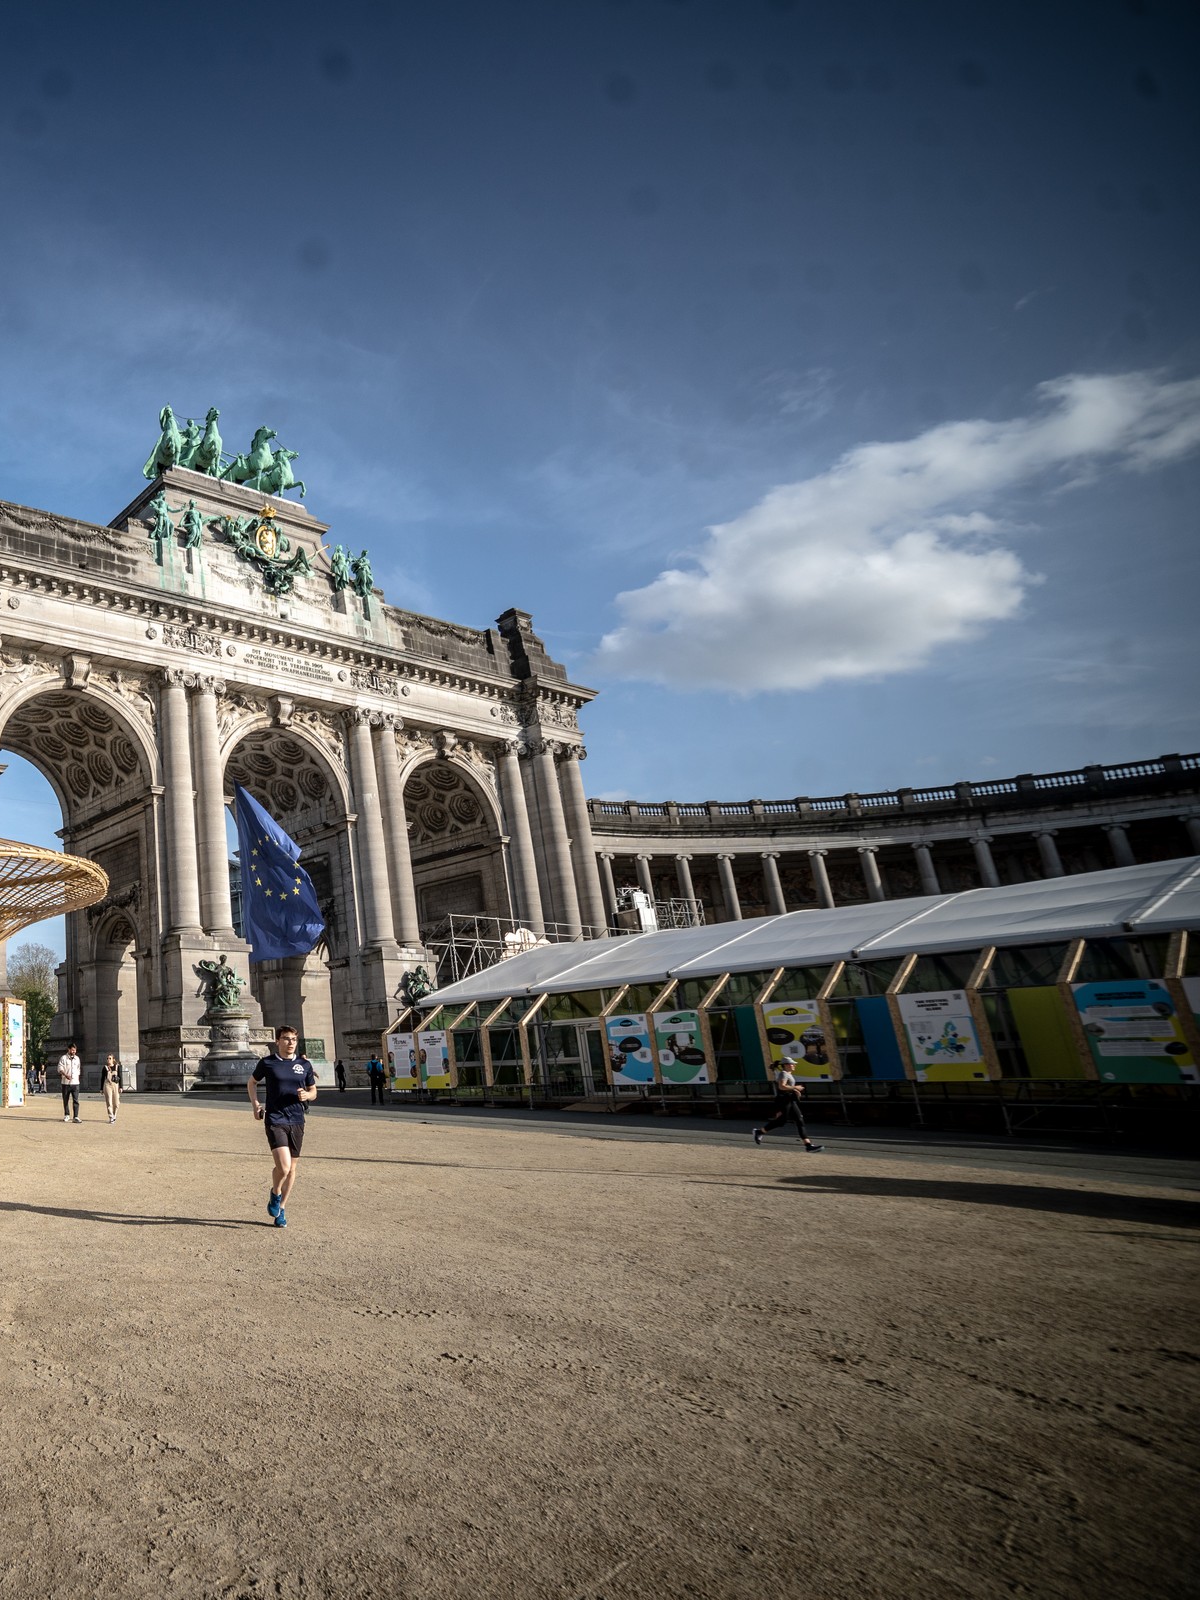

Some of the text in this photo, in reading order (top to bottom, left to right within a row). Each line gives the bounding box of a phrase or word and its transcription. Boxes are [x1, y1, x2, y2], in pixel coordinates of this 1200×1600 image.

[246, 653, 275, 663] OPGERICHT
[264, 652, 293, 662] MONUMENT
[281, 667, 333, 682] ONAFHANKELIJKHEID
